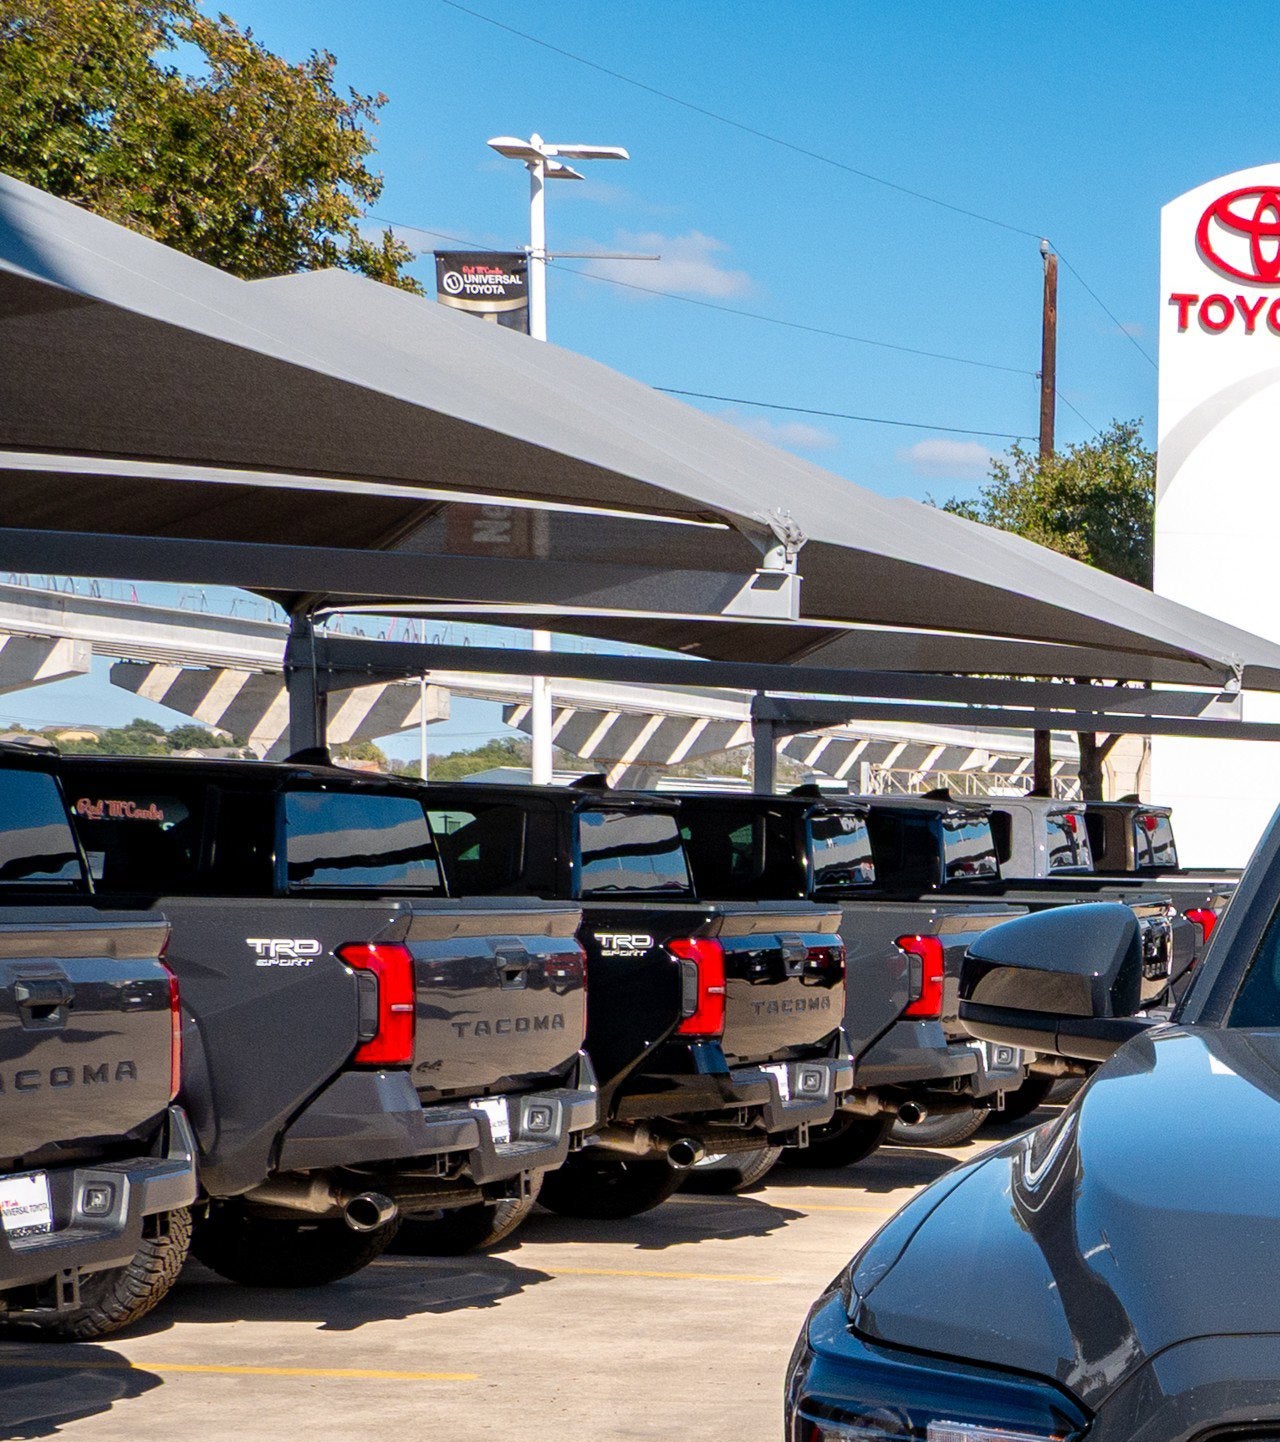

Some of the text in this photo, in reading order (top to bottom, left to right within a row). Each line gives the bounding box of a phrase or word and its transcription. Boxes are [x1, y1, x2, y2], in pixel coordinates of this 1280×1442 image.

[464, 274, 522, 285] UNIVERSAL
[464, 284, 505, 294] TOYOTA
[245, 938, 323, 959] TRD
[594, 933, 654, 949] TRD
[751, 995, 831, 1016] TACOMA
[452, 1013, 565, 1038] TACOMA
[0, 1060, 137, 1094] COMA
